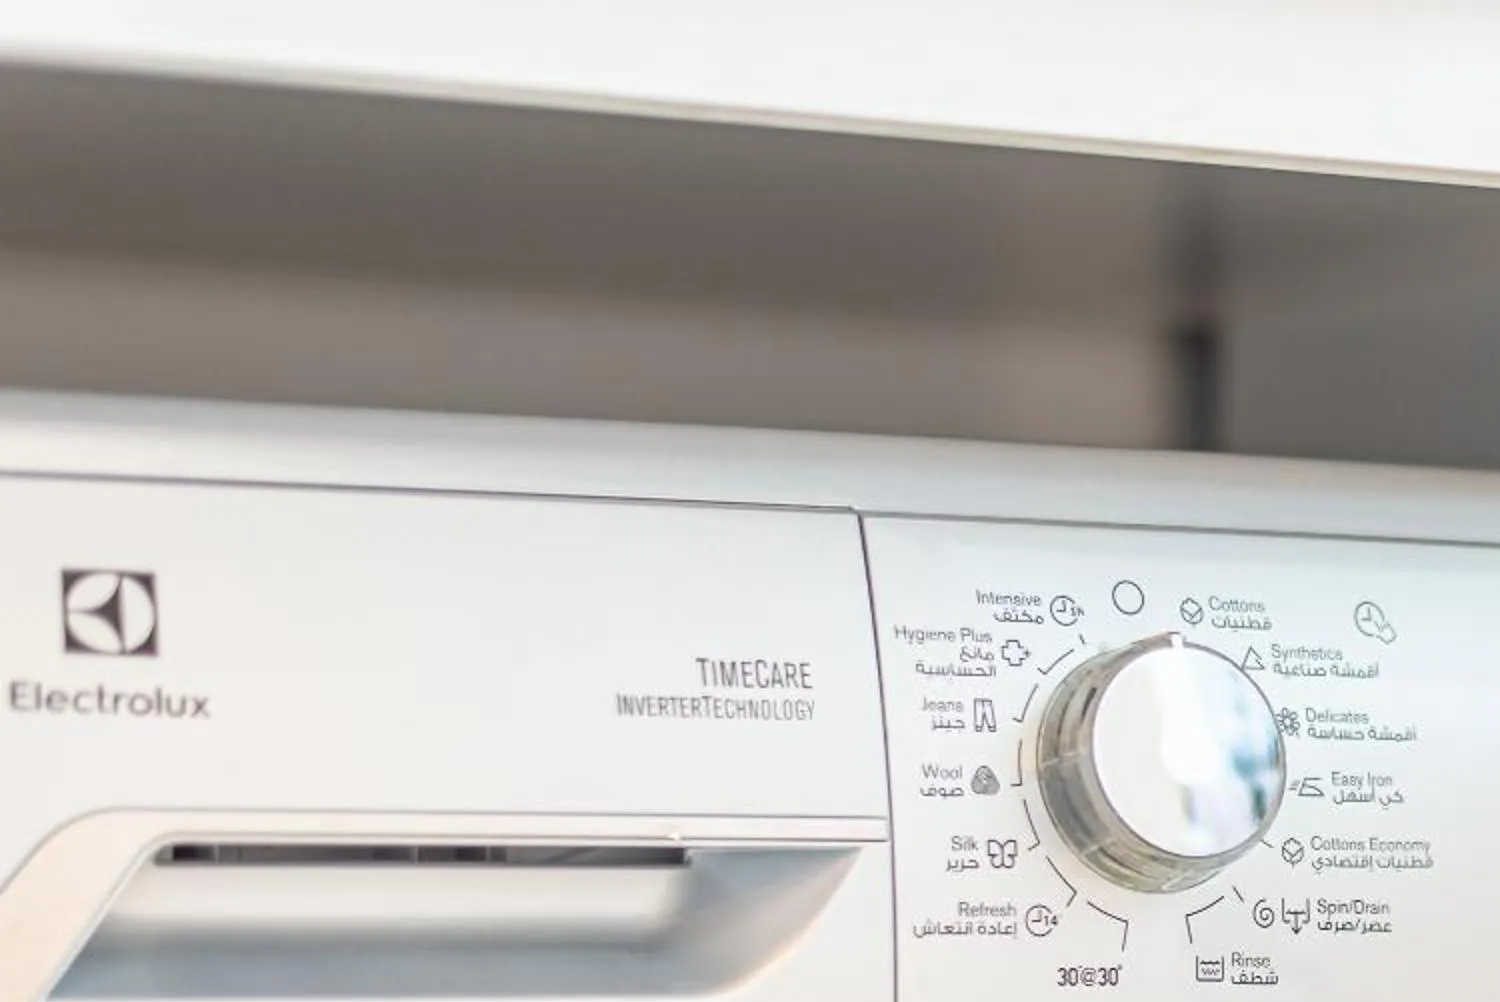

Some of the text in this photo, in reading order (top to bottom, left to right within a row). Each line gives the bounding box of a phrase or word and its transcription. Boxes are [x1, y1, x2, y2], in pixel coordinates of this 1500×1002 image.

[975, 589, 1042, 606] Intensive
[1208, 595, 1266, 613] Cottons
[893, 625, 993, 644] Hygiene Plus
[1271, 643, 1343, 662] Synthetics
[9, 680, 209, 719] Electrolux
[922, 696, 964, 712] Jeans
[1305, 707, 1369, 724] Delicates
[921, 764, 963, 779] Wool
[1331, 771, 1393, 790] Easy Iron
[951, 835, 979, 851] Silk
[1310, 835, 1431, 855] Cottons Economy
[958, 901, 1017, 917] Refresh
[1317, 898, 1391, 920] Spin/Drain
[1231, 951, 1271, 968] Rinse
